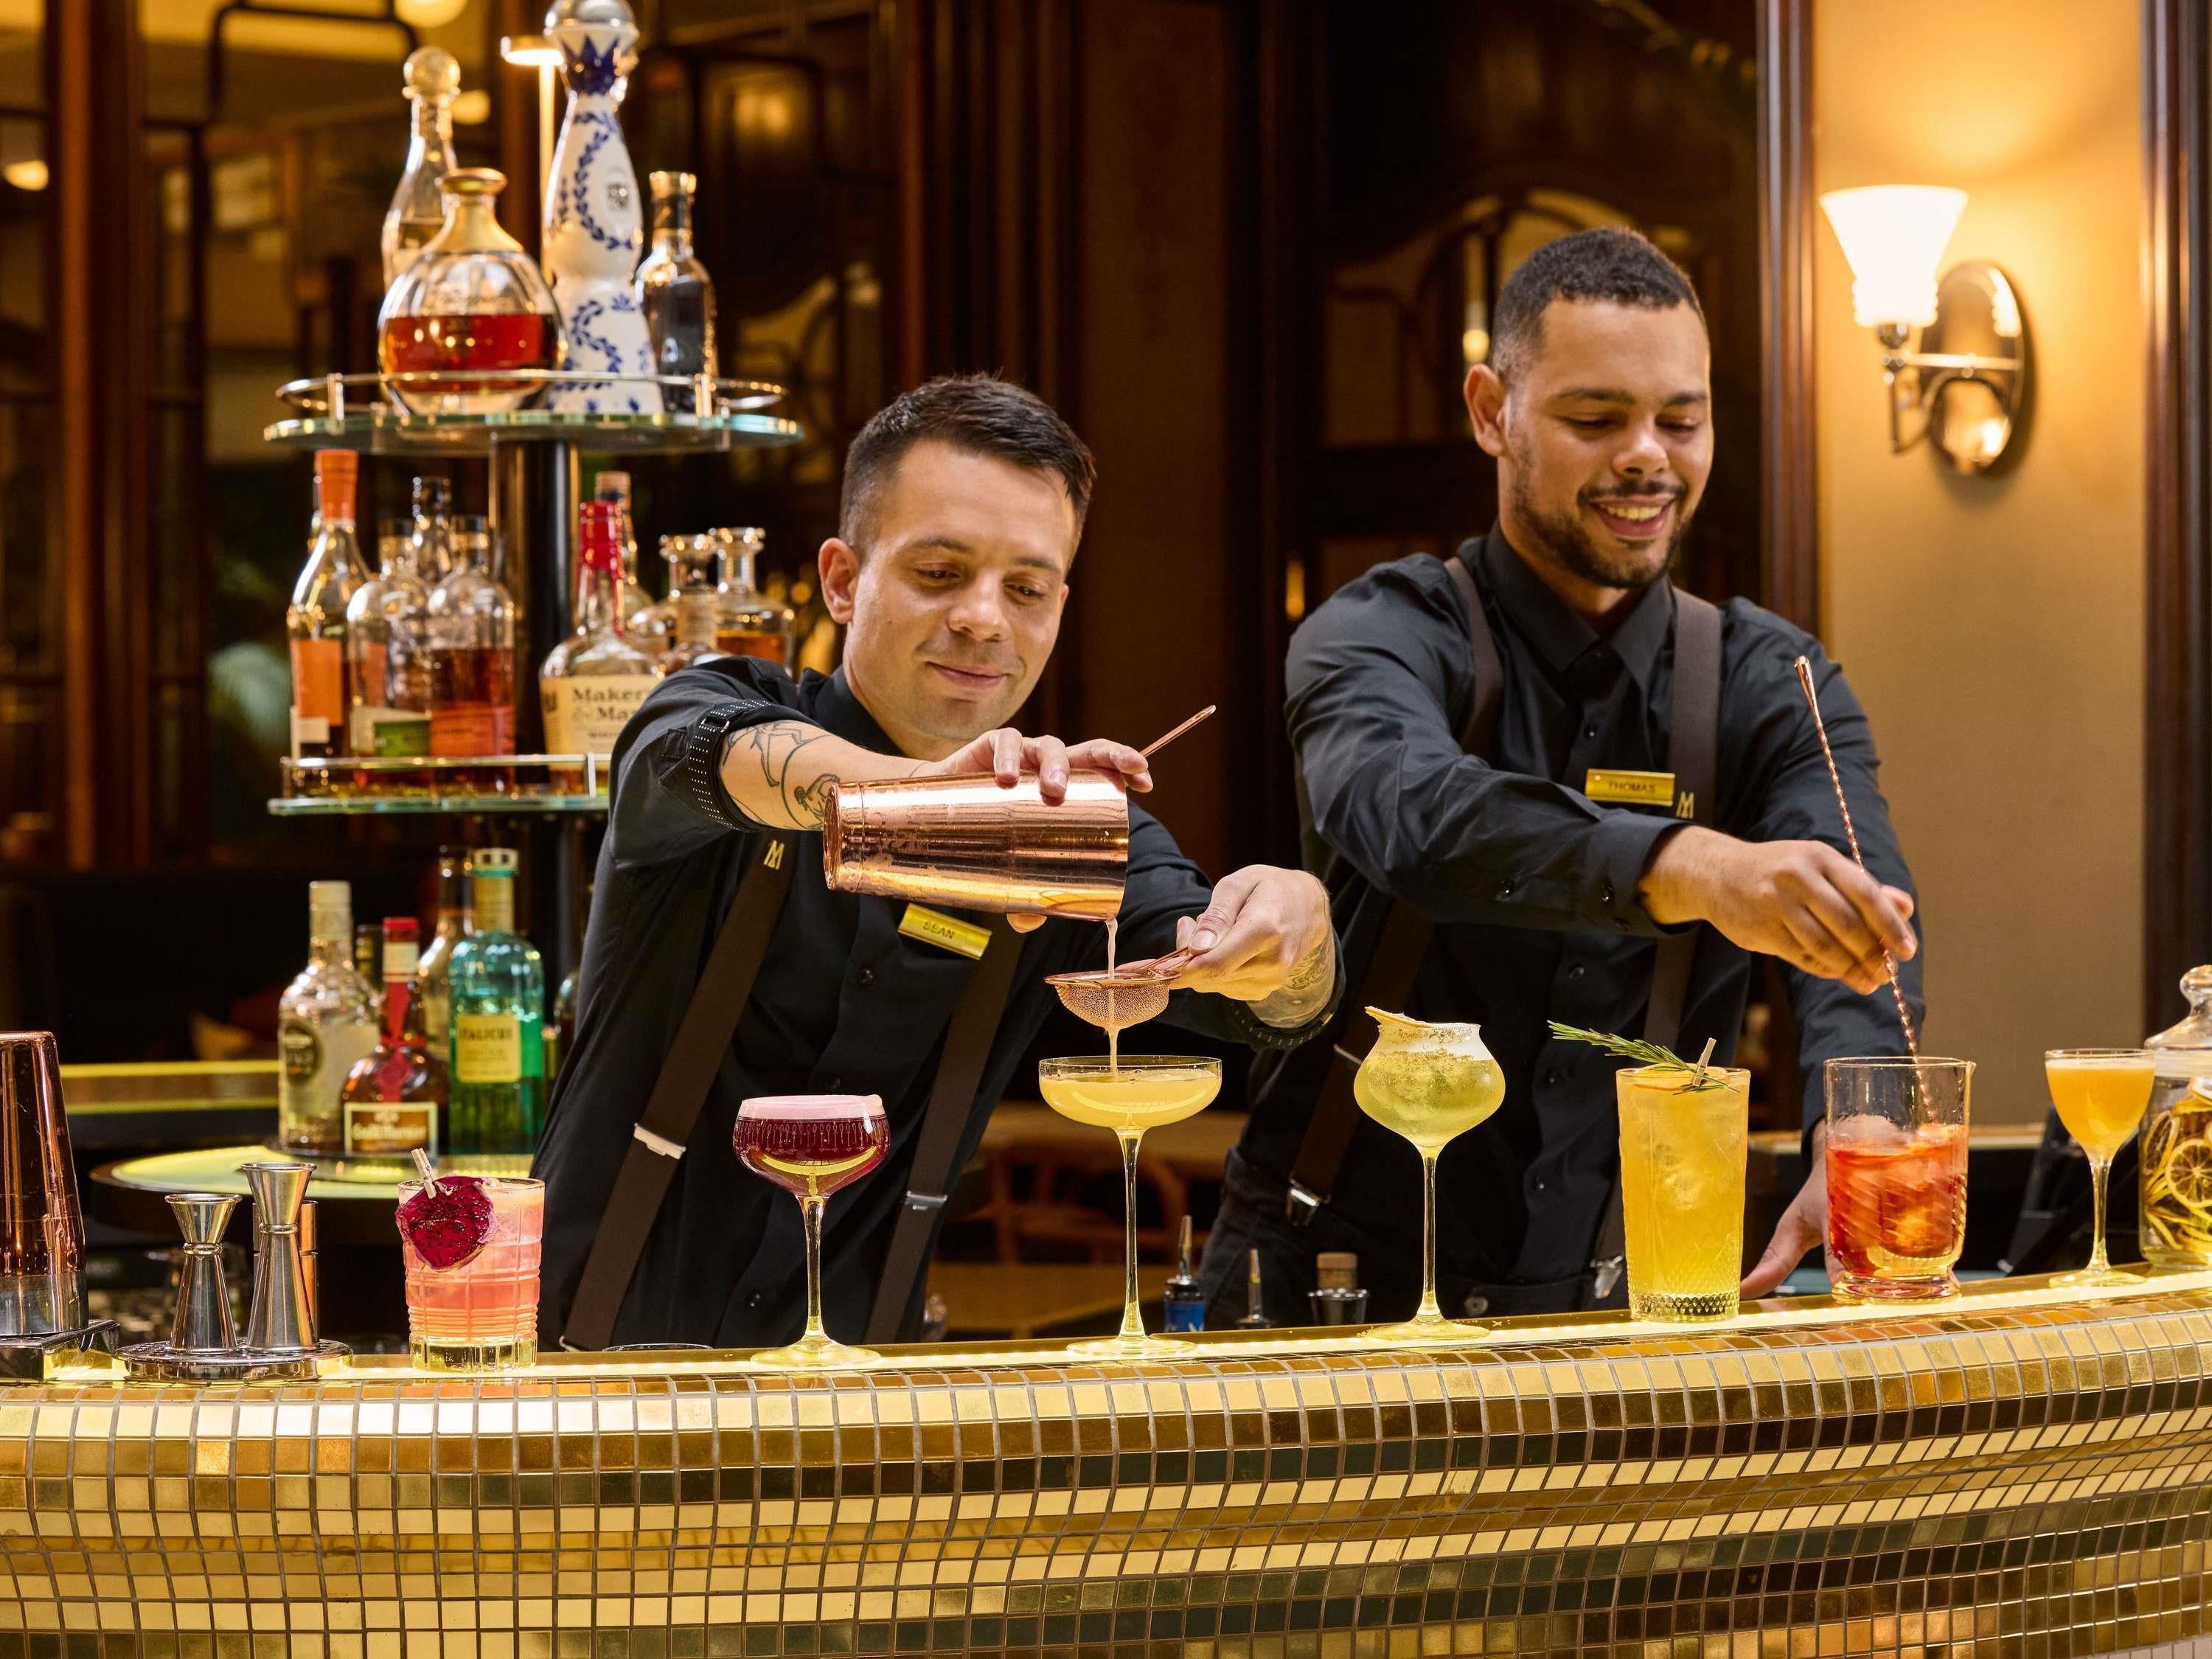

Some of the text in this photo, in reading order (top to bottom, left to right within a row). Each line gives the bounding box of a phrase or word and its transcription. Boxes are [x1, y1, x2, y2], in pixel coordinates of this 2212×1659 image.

[572, 686, 650, 701] Maker'
[598, 706, 631, 720] Ma
[1608, 779, 1656, 794] THOMAS
[922, 921, 955, 939] SEAN
